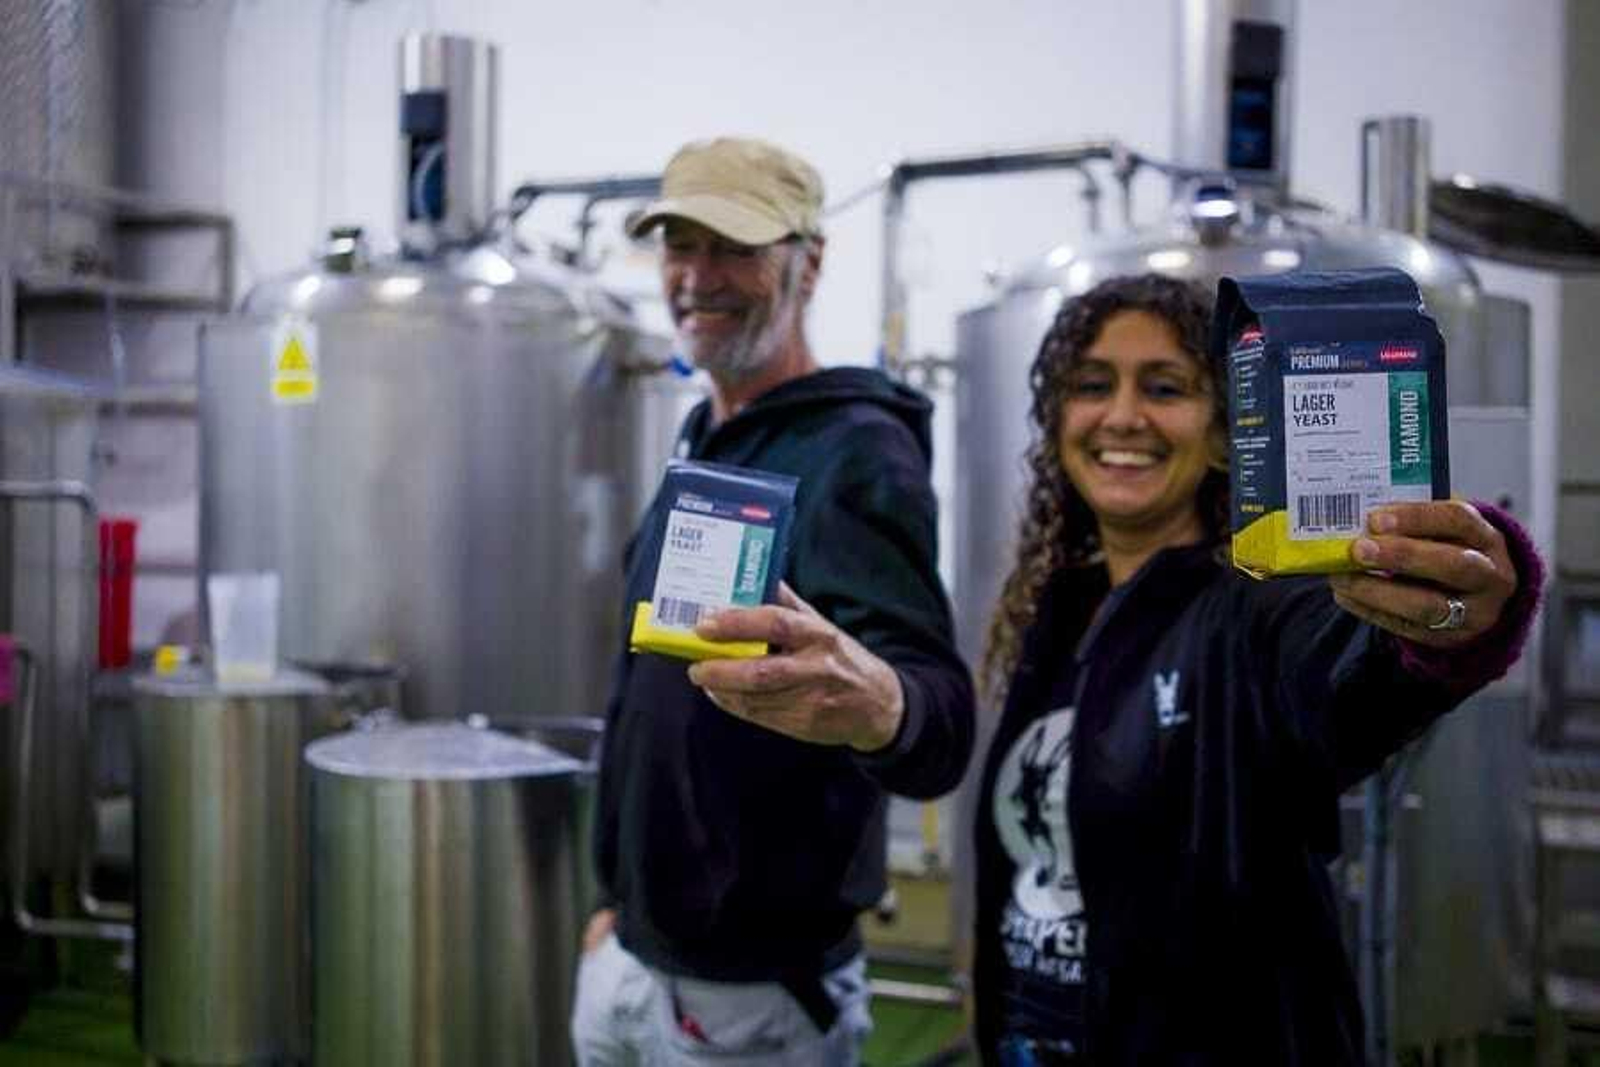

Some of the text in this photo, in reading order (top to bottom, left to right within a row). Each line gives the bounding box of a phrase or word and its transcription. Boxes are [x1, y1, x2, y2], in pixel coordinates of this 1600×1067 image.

[1290, 355, 1340, 371] PREMIUM
[1293, 394, 1336, 413] LAGER
[1294, 413, 1338, 427] YEAST
[1399, 391, 1420, 463] DIAMOND
